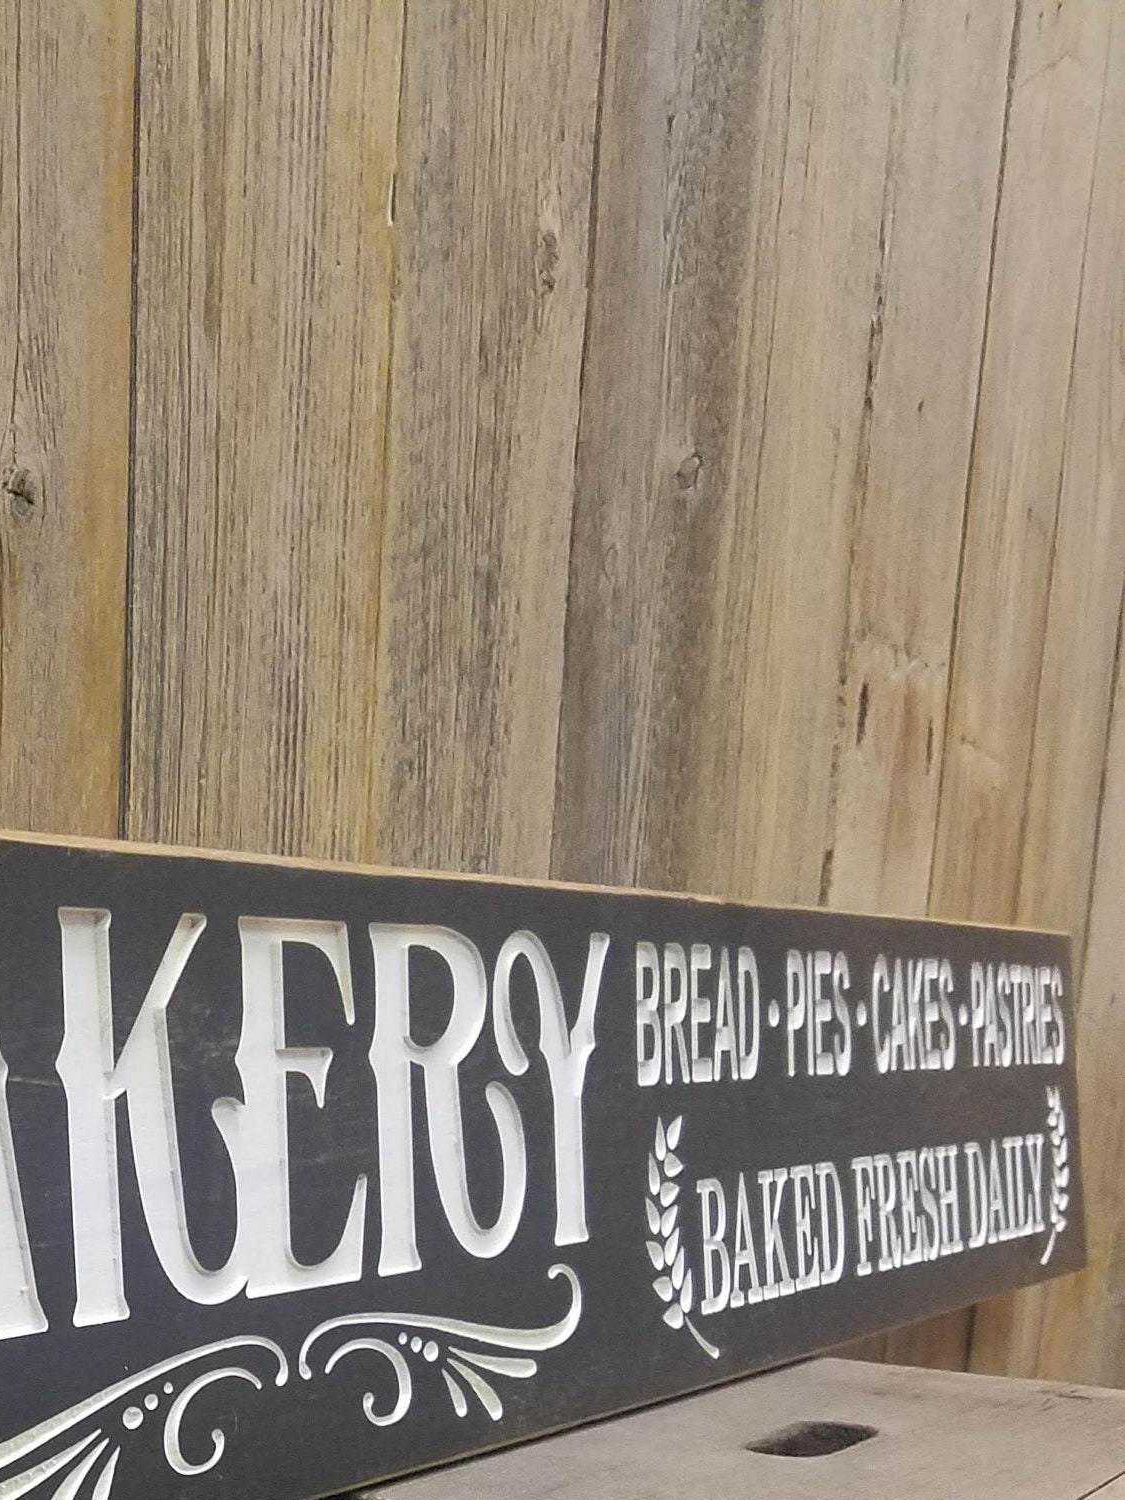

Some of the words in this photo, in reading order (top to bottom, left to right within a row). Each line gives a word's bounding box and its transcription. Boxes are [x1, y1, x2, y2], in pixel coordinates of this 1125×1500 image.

[636, 941, 760, 1086] BREAD
[787, 949, 851, 1076] PIES
[872, 953, 956, 1073] CAKES
[971, 961, 1064, 1068] PASTRIES
[696, 1159, 845, 1315] BAKED
[851, 1143, 964, 1276] FRESH
[964, 1133, 1046, 1248] DAILY
